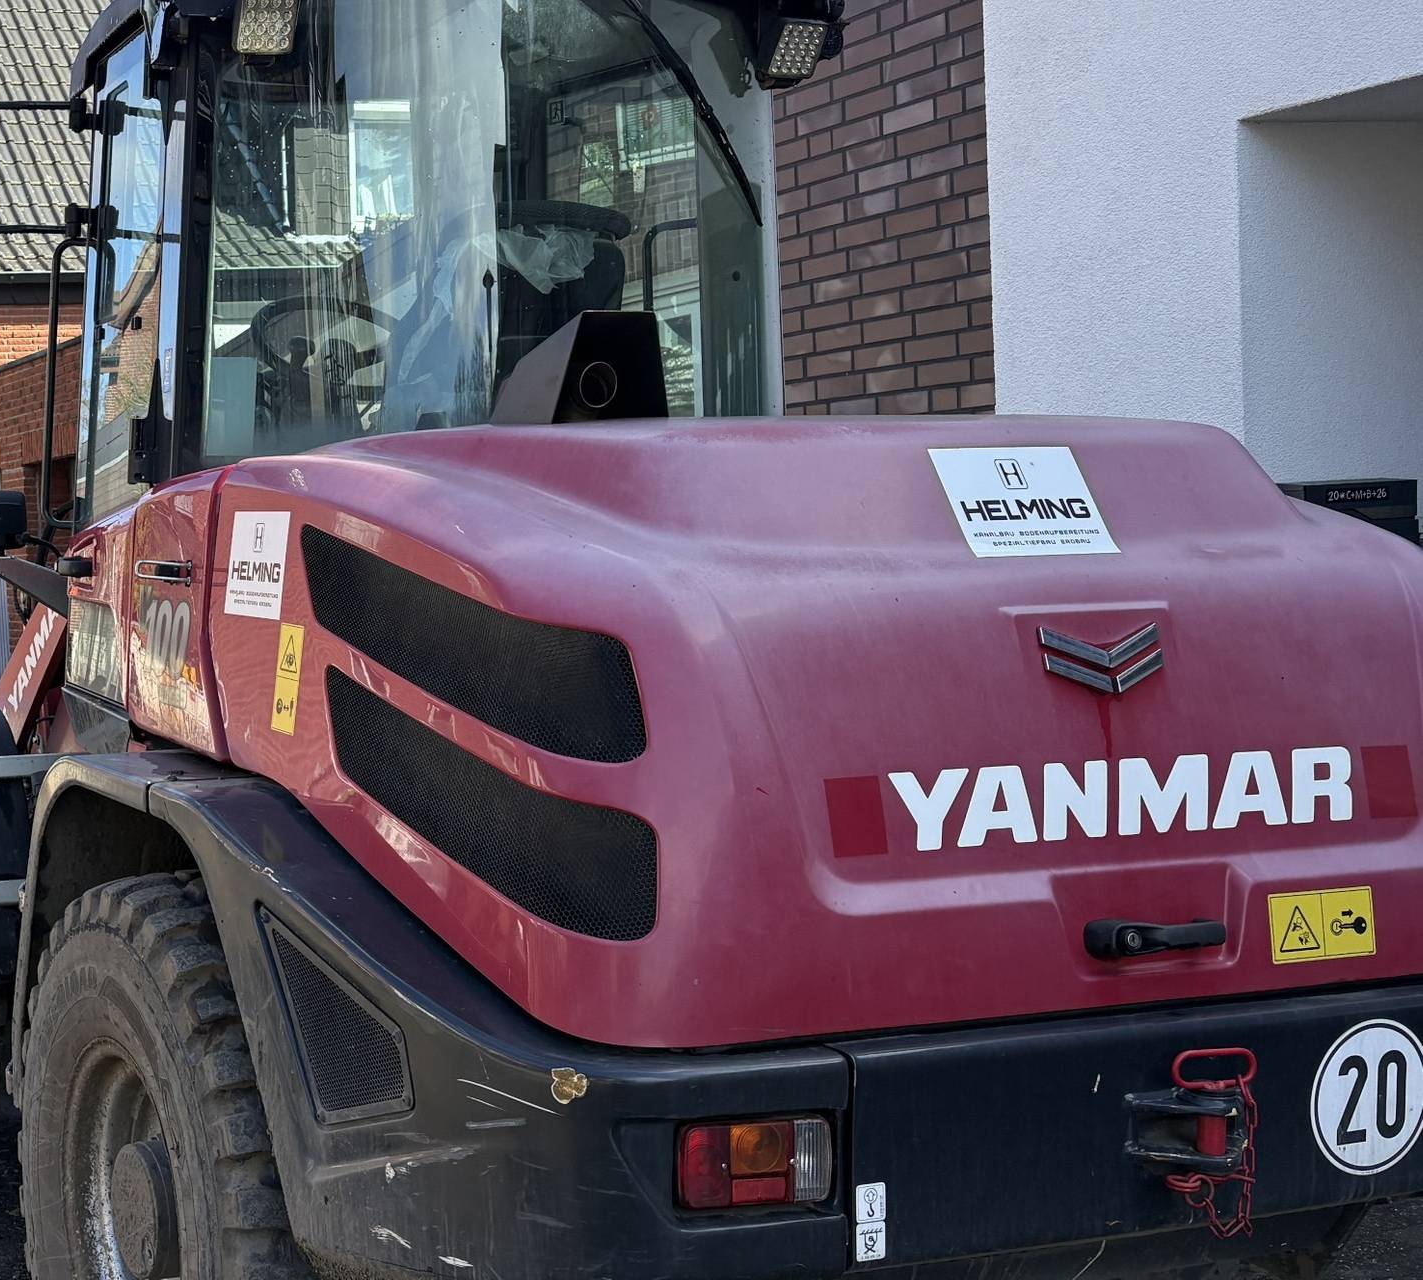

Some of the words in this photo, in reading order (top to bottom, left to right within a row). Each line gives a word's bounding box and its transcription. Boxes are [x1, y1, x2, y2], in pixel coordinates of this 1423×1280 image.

[998, 461, 1025, 487] H
[960, 498, 1092, 522] HELMING
[973, 531, 1015, 539] KANALBAU
[231, 560, 282, 584] HELMING
[8, 607, 59, 712] YANMA
[887, 746, 1353, 852] YANMAR
[1337, 1050, 1408, 1146] 20
